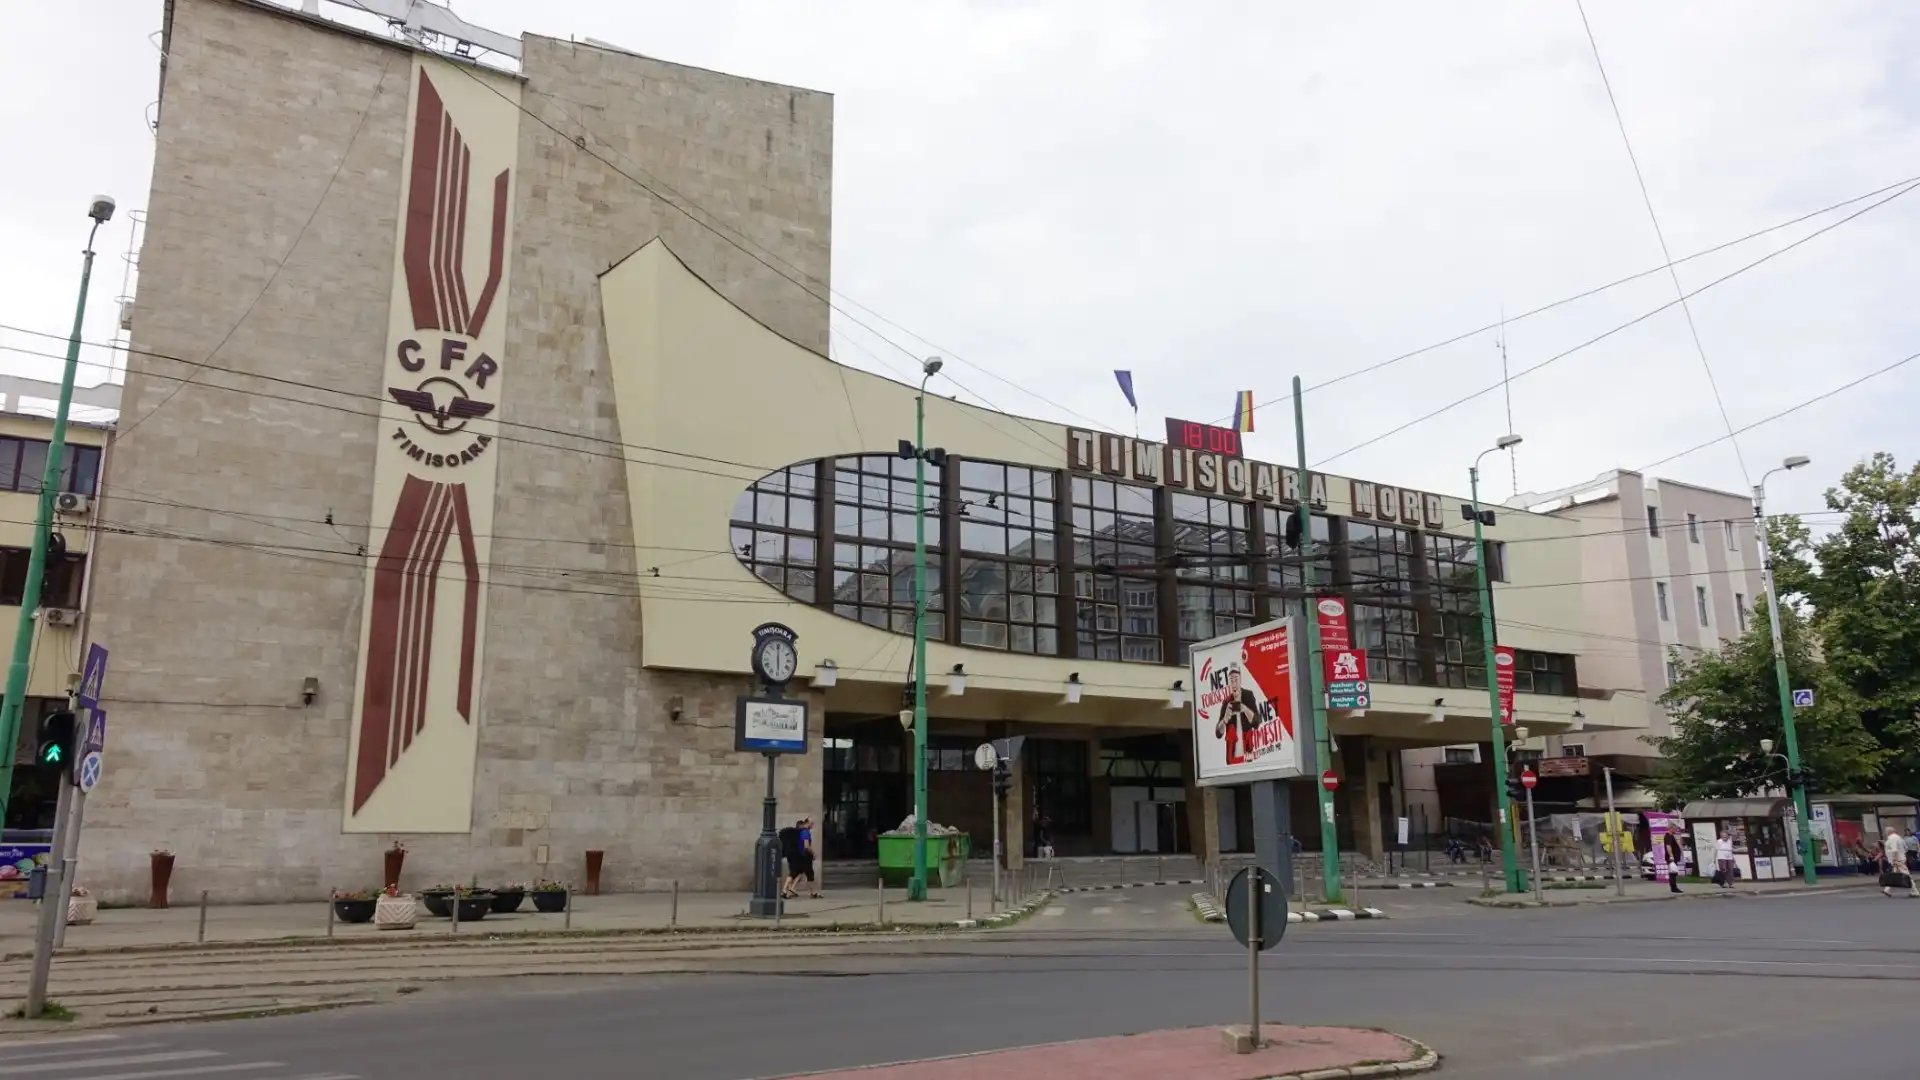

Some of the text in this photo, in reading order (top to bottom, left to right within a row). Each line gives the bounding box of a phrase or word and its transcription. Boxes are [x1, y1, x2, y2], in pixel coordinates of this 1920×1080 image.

[397, 338, 498, 390] CFR
[392, 426, 492, 467] TIMISOARA
[1354, 482, 1443, 525] NORD
[1211, 667, 1228, 691] NET
[1259, 697, 1278, 722] NET
